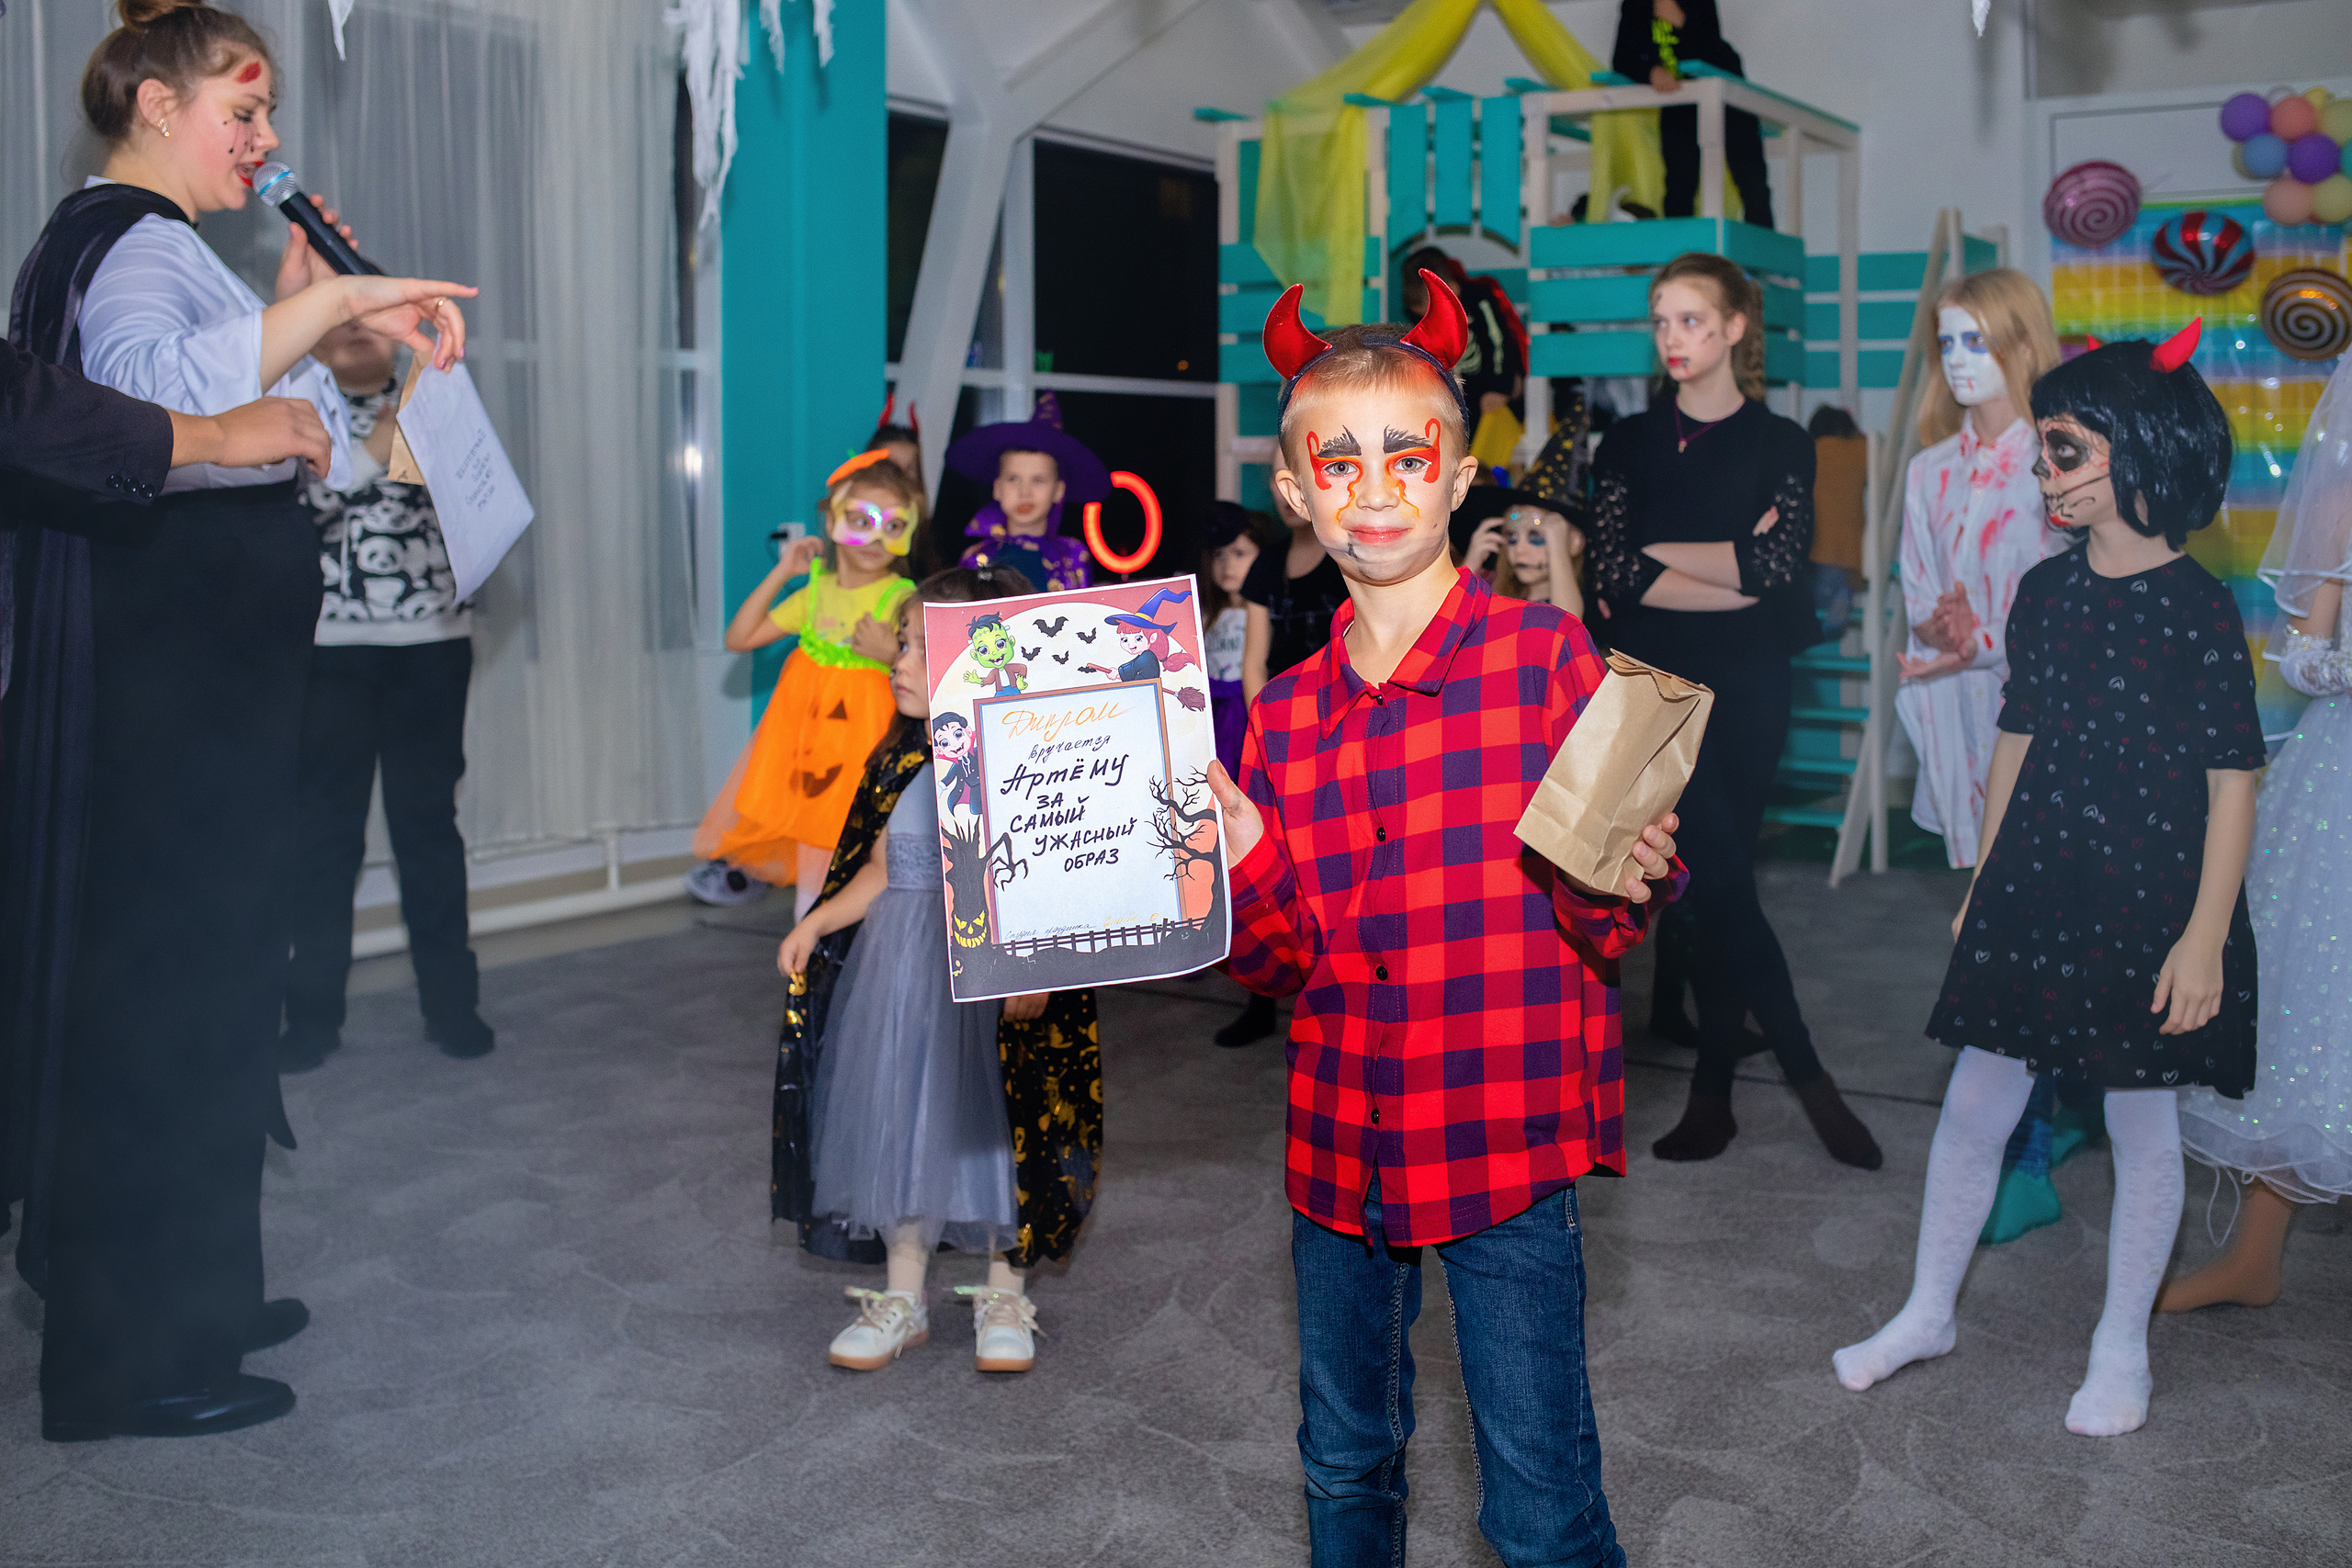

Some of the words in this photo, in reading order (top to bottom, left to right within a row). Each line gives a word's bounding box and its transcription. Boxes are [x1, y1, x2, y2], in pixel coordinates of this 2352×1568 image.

[1001, 701, 1136, 742] Диплом
[1032, 817, 1138, 856] УЖАСНЫЙ
[1064, 848, 1119, 872] ОБРАЗ
